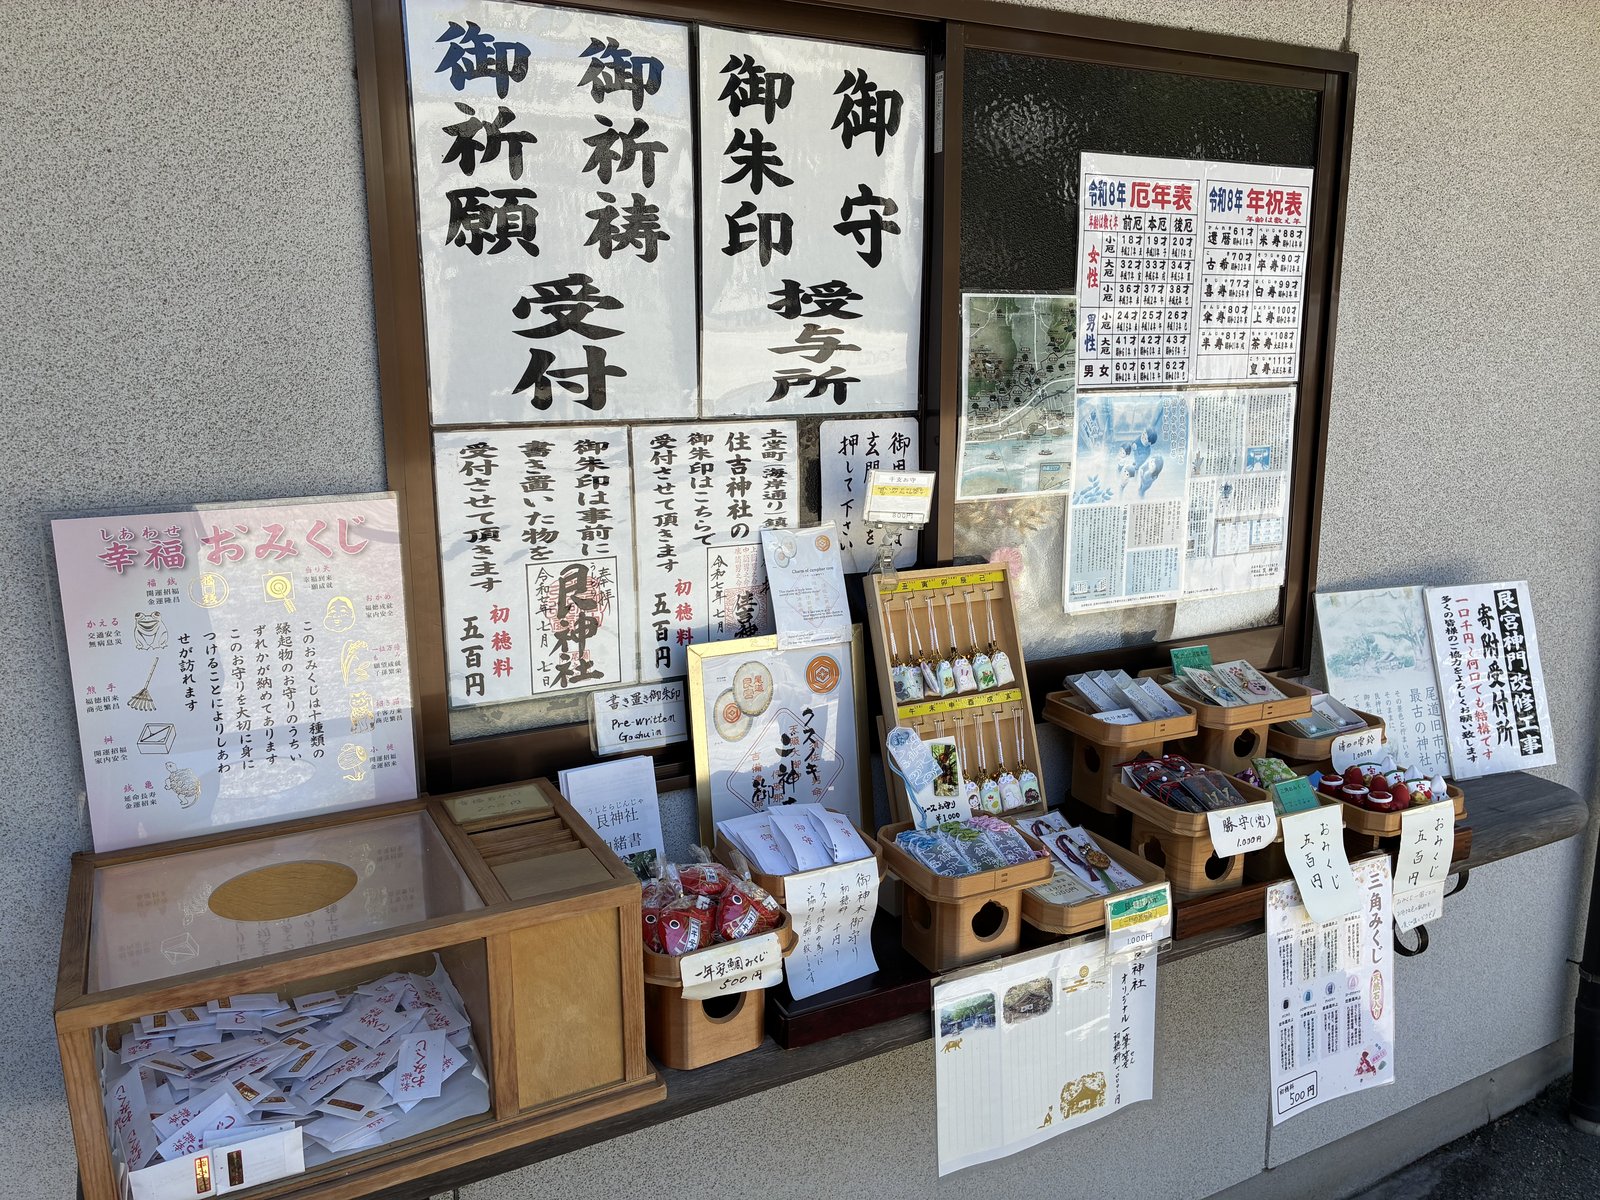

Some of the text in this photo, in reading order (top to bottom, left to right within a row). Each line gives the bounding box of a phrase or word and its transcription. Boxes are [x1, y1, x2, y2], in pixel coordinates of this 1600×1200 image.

[434, 20, 540, 257] 御祈願
[578, 36, 670, 263] 御祈祷
[717, 53, 795, 267] 御朱印
[831, 68, 903, 268] 御守
[1088, 179, 1192, 211] 令和8年 厄年表
[1123, 215, 1142, 231] 前厄
[1148, 216, 1167, 231] 本厄
[1174, 217, 1193, 232] 後厄
[1209, 186, 1302, 216] 令和8年 年祝表
[1087, 244, 1100, 288] 女性
[1105, 236, 1116, 253] 小厄
[1122, 235, 1142, 245] 18才
[1147, 236, 1167, 246] 19才
[1173, 237, 1193, 247] 20才
[1206, 257, 1229, 271] 古希
[1232, 253, 1252, 262] 70才
[1281, 255, 1300, 263] 90才
[1233, 227, 1254, 237] 61才
[1259, 234, 1281, 248] 米寿
[1283, 230, 1303, 239] 88才
[1102, 284, 1190, 302] 小厄 36才 37才 38才
[1104, 259, 1191, 277] 大厄 32才 33才 34才
[1204, 280, 1298, 298] 喜寿 77才 白寿 99才
[511, 273, 627, 410] 受付
[766, 280, 863, 406] 授与所
[1084, 313, 1097, 352] 男性
[1100, 310, 1188, 330] 小厄 24才 25才 26才
[1225, 331, 1246, 340] 81才
[1251, 337, 1272, 350] 茶寿
[1228, 306, 1248, 314] 80才
[1253, 311, 1275, 324] 上寿
[1277, 306, 1297, 314] 100才
[1083, 361, 1186, 378] 男女 60才 61才 62才
[1100, 336, 1187, 355] 大厄 41才 42才 43才
[1250, 362, 1271, 375] 皇寿
[517, 440, 560, 560] 書き置いた物を
[573, 438, 613, 557] 御朱印は事前に
[649, 433, 680, 574] 受付させて頂きます
[724, 431, 753, 539] 住吉神社の
[838, 434, 859, 551] 押して下さい
[98, 515, 369, 573] 幸福 おみくじ
[100, 526, 181, 540] しあわせ
[458, 441, 503, 593] 受付させて頂きます
[87, 618, 119, 629] かえる
[88, 630, 121, 639] 交通安全
[366, 610, 394, 618] 家内安全
[548, 564, 604, 688] 艮神社
[651, 593, 673, 669] 五百円
[674, 577, 694, 646] 初穂料
[462, 615, 486, 697] 五百円
[489, 604, 514, 678] 初穂料
[87, 683, 116, 695] 熊手
[178, 634, 197, 711] せが訪れます
[230, 629, 254, 770] このお守りを大切に身に
[254, 625, 277, 764] ずれかが納めてあります
[275, 622, 302, 761] 縁起物のお守りのうちい
[303, 621, 325, 758] このおみくじは十種類の
[606, 687, 680, 710] 書き置き御朱印
[1477, 603, 1514, 746] 寄附受付所
[203, 632, 230, 773] つけることによりしあわ
[1410, 688, 1434, 772] 最古の神社。
[1426, 686, 1448, 765] 尾道旧市内
[95, 755, 128, 764] 家内安全
[588, 798, 644, 815] うしとらじんじゃ
[597, 807, 639, 829] 艮神社
[1300, 833, 1323, 889] 五百円
[1320, 822, 1340, 890] おみくじ
[1408, 829, 1427, 886] 五百円
[1430, 818, 1444, 878] おみくじ
[1368, 872, 1383, 964] 三角みくじ
[719, 970, 762, 990] 500円
[412, 1040, 427, 1088] おみくじ
[1289, 1085, 1315, 1106] 500円
